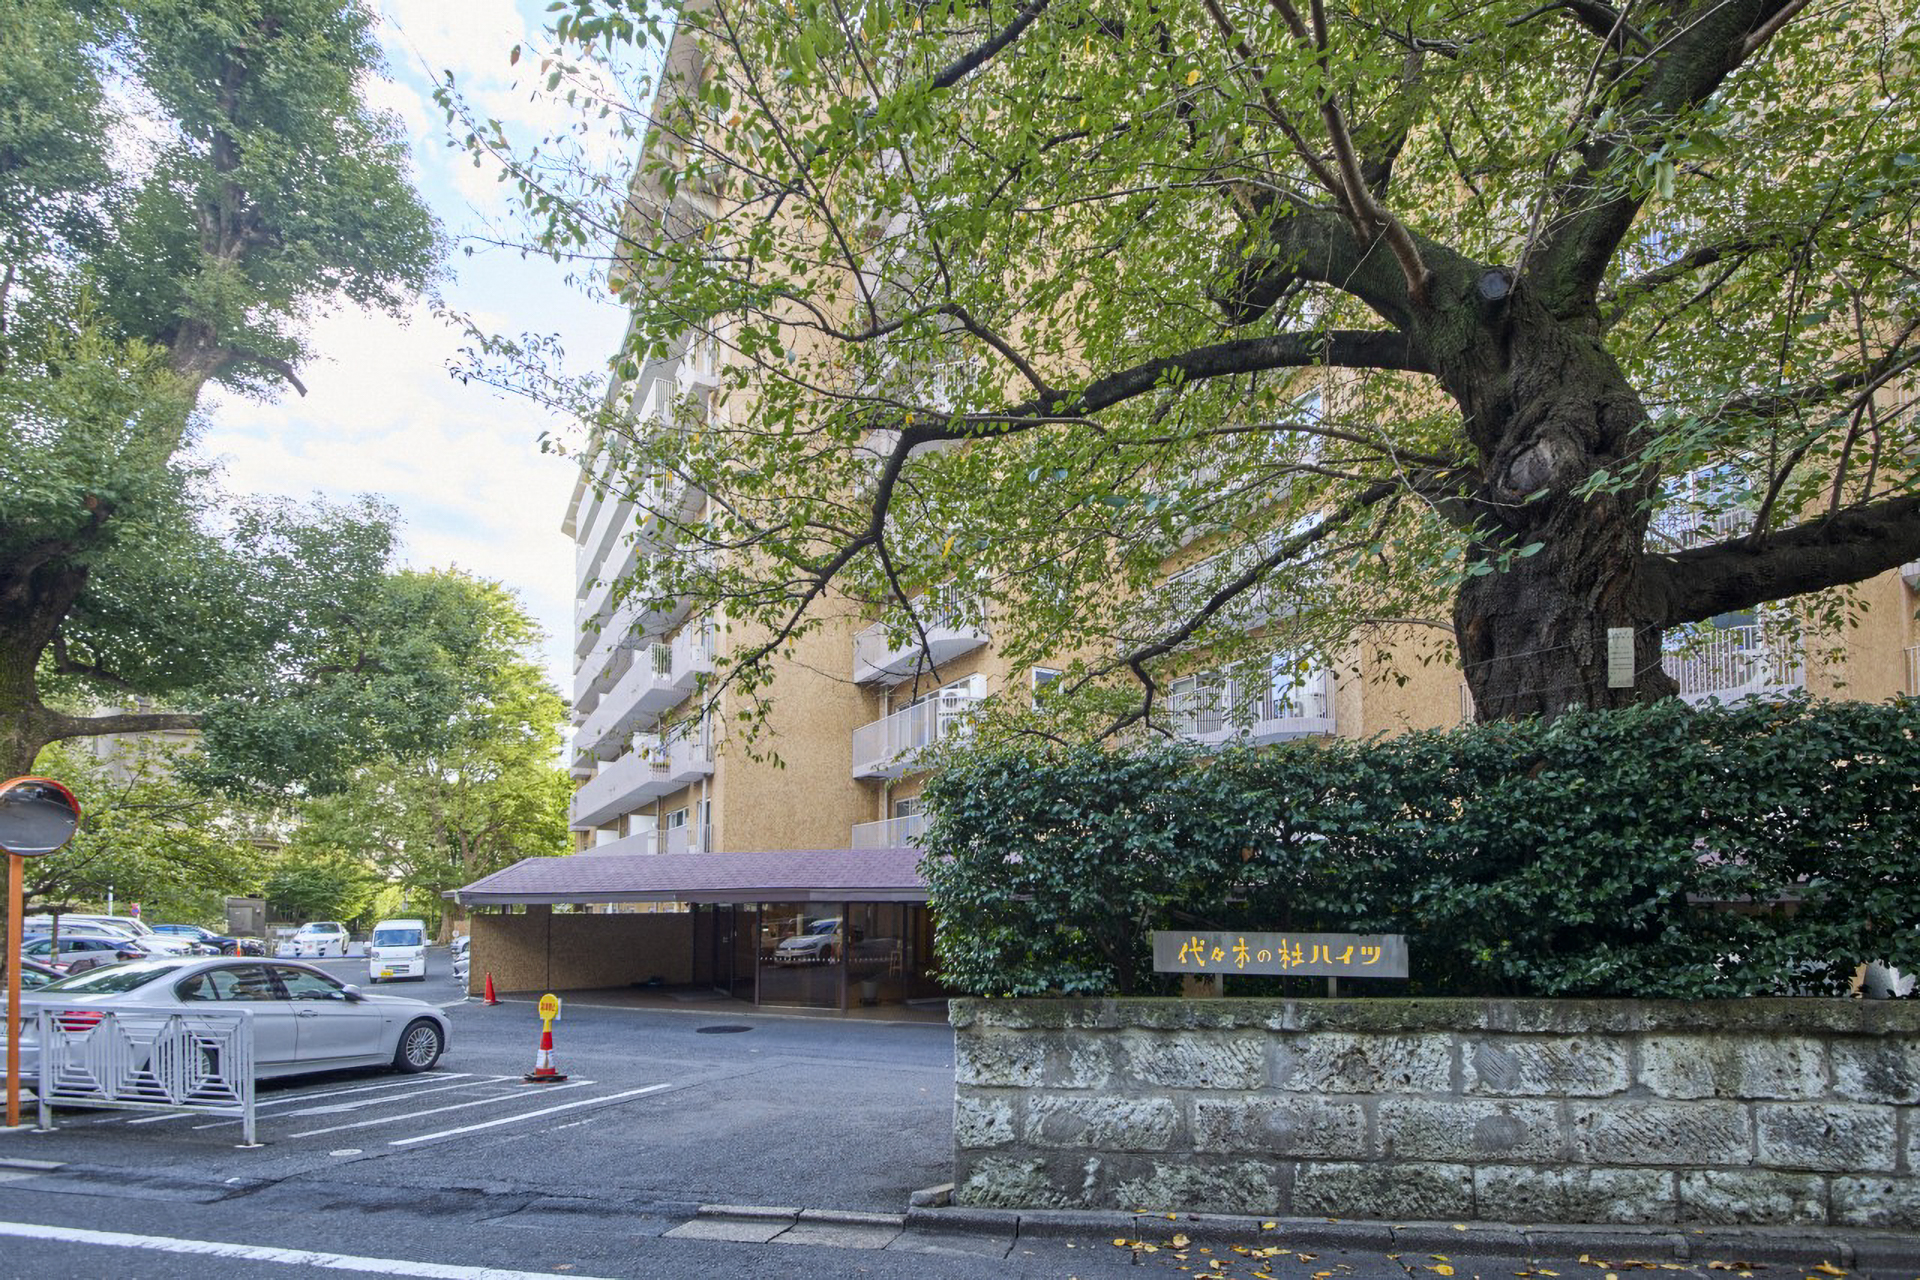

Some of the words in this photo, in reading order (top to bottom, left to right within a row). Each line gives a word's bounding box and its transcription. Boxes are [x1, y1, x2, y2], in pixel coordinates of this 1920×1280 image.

[1178, 936, 1381, 970] 代々木の杜ハイツ
